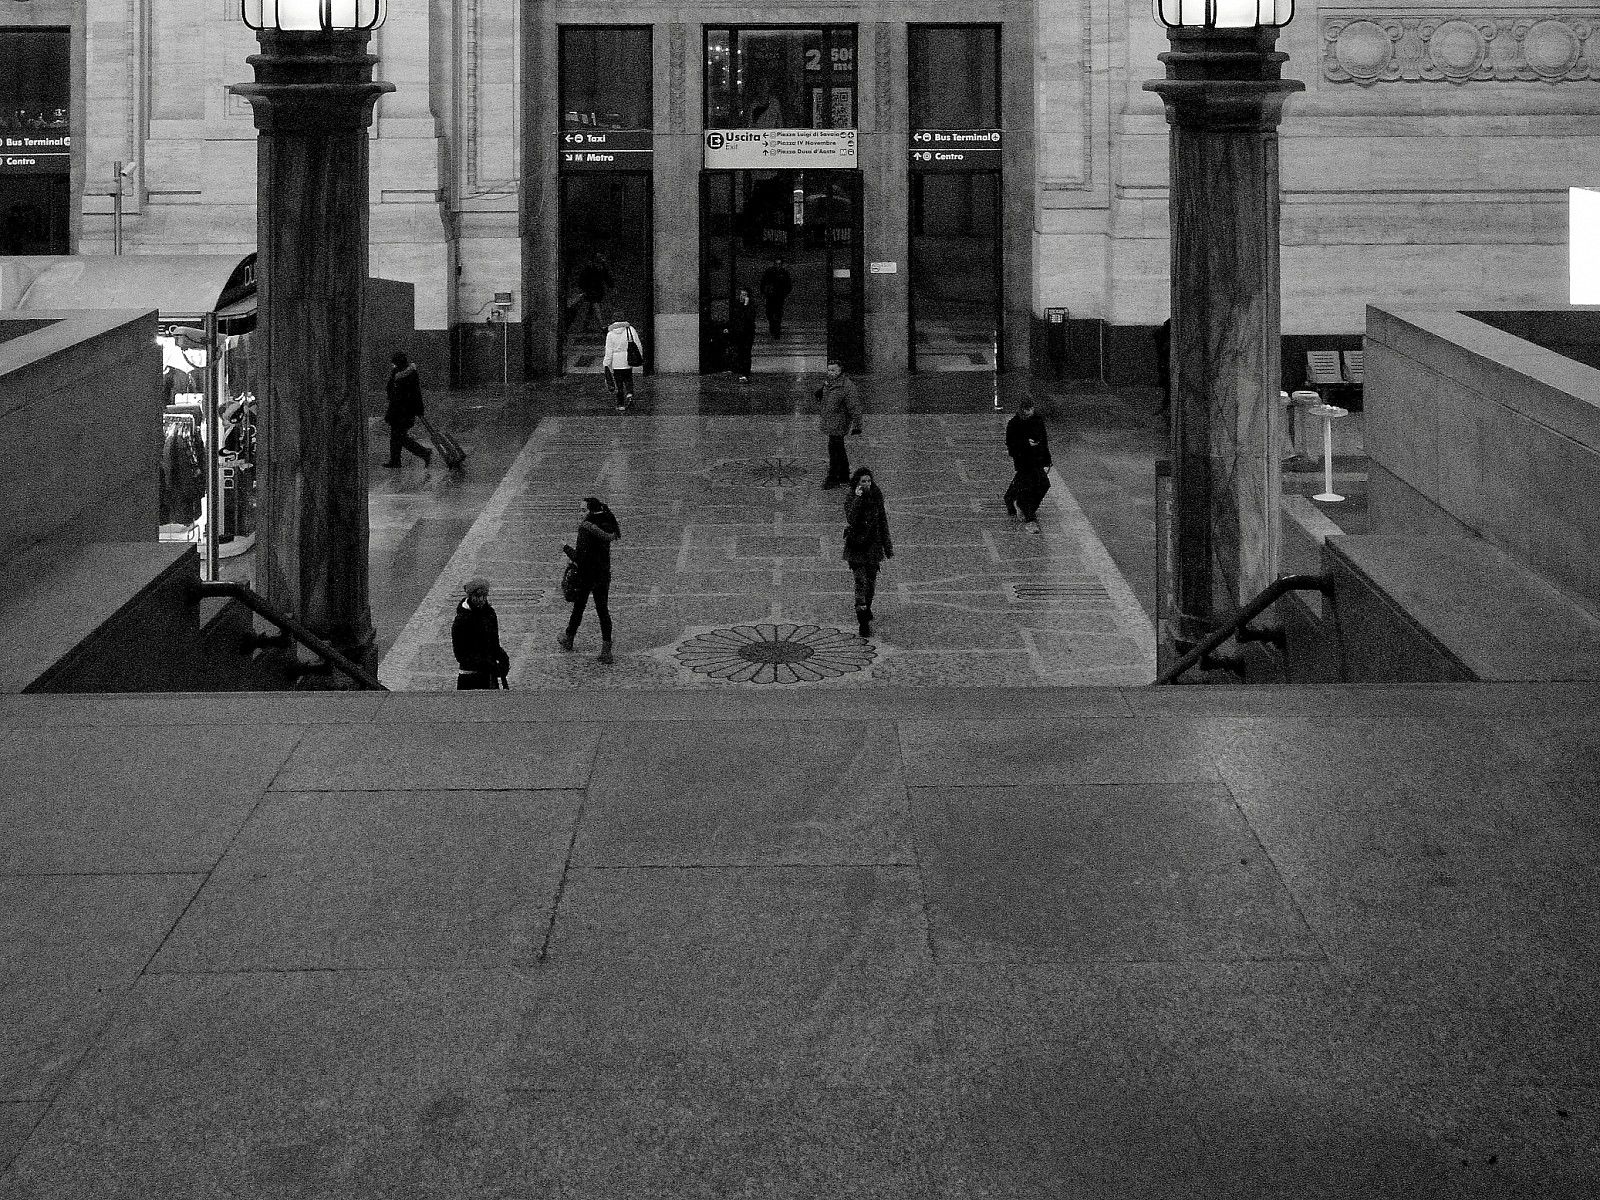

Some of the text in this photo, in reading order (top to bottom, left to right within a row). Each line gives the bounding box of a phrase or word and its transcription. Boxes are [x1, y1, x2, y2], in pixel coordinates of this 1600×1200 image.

[586, 134, 606, 142] Taxi
[725, 132, 761, 142] Uscita
[797, 131, 812, 139] Luigi
[934, 132, 991, 141] Bus Terminal
[6, 137, 63, 146] Bus Terminal
[725, 142, 738, 150] Exit
[586, 153, 614, 162] Metro
[935, 152, 964, 160] Centro
[6, 157, 36, 165] Centro
